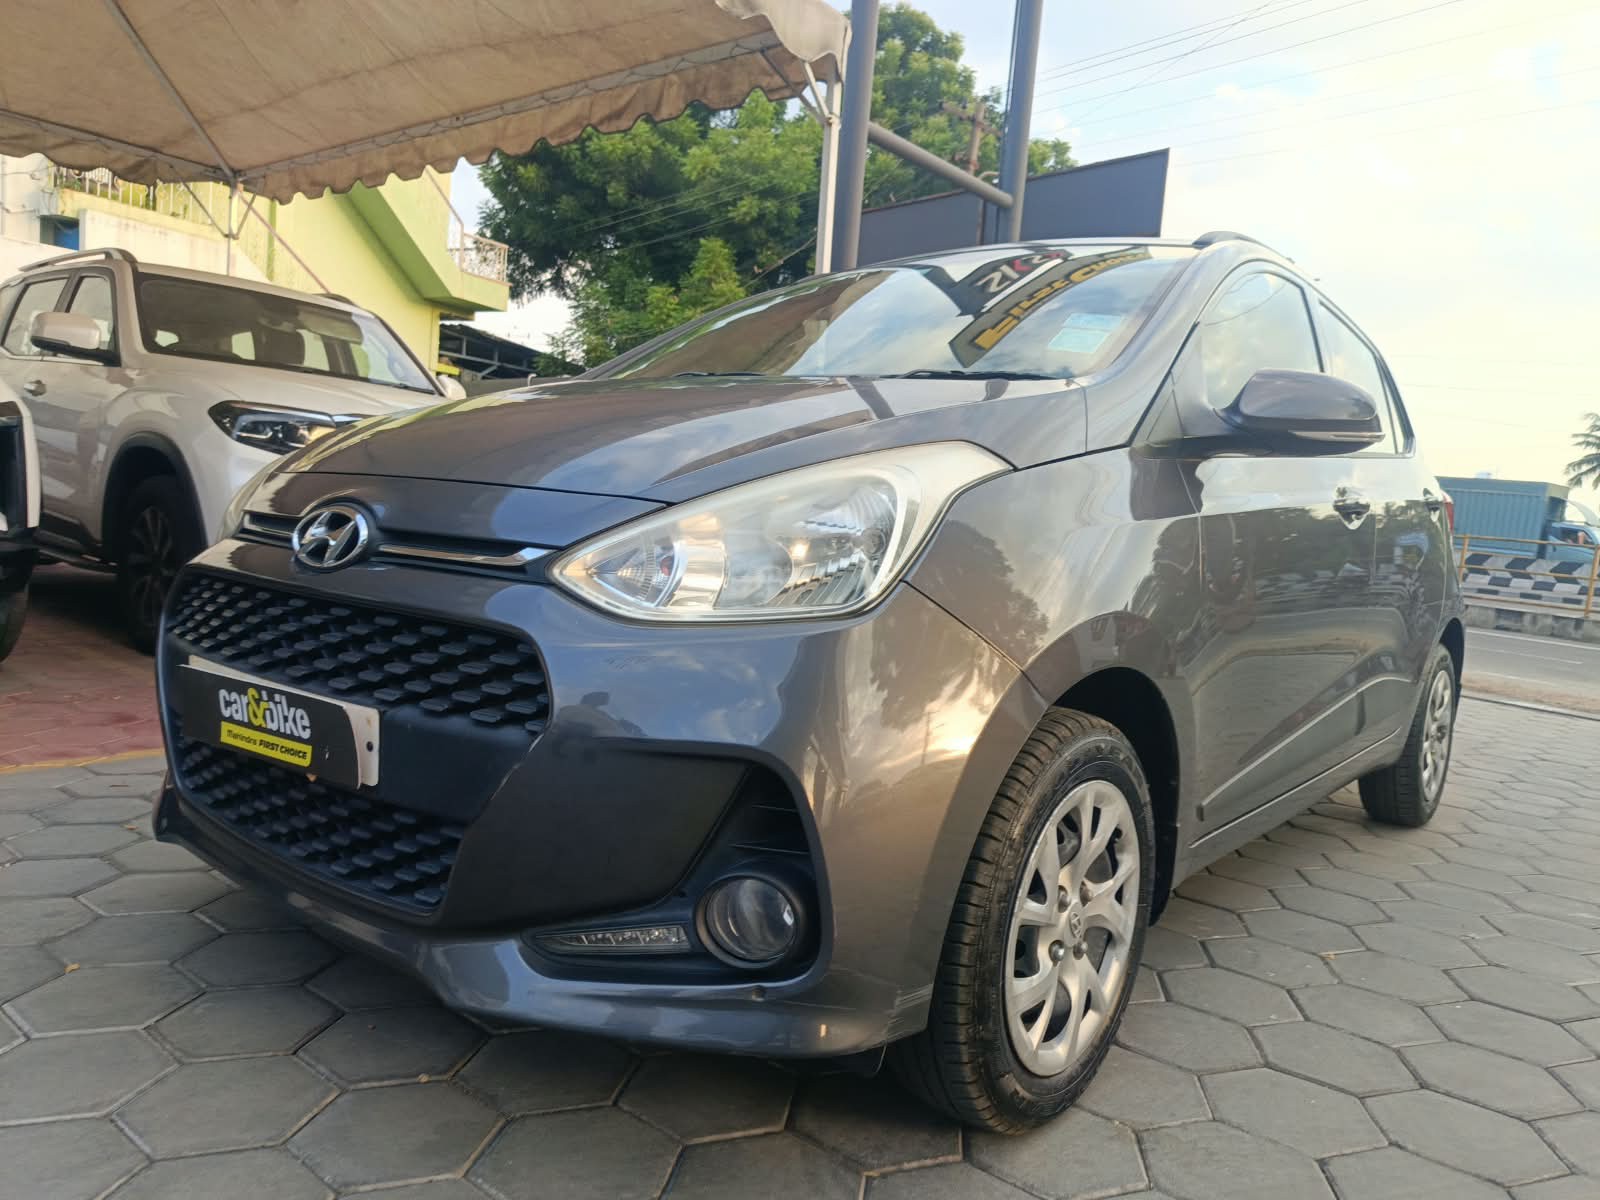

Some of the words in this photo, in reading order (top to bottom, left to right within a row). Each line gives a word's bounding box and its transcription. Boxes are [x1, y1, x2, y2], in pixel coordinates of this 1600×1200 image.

[218, 687, 311, 740] car&bike
[258, 739, 280, 752] FIRST
[280, 745, 308, 760] CHOICE
